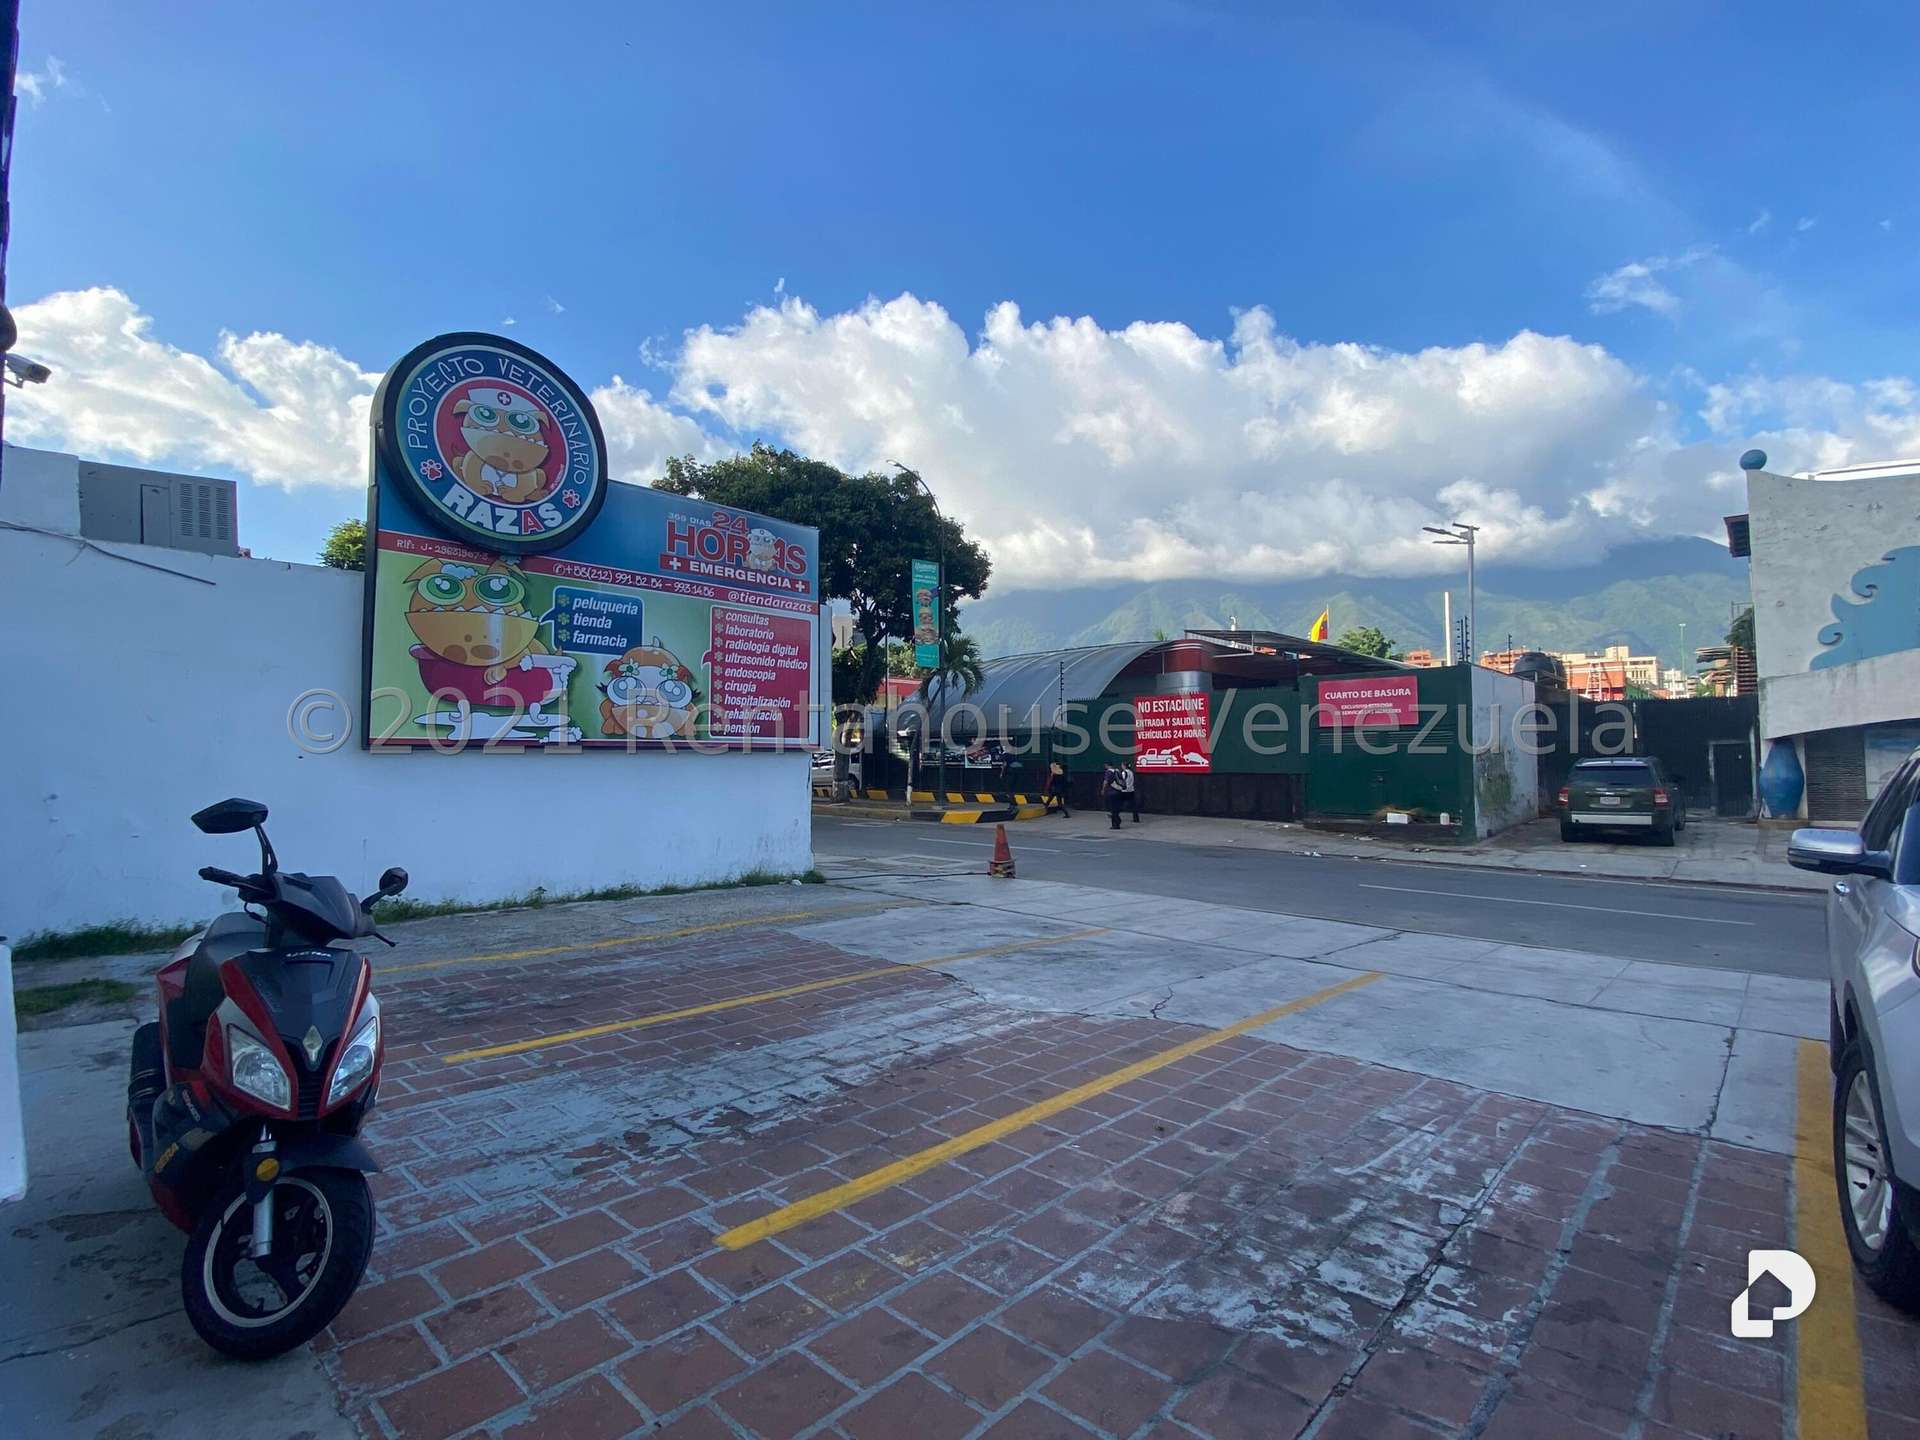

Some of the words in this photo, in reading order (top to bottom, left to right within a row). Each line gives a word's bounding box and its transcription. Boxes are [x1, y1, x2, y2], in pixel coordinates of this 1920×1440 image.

[408, 356, 484, 449] PROYECTO
[498, 358, 590, 485] VETERINARIO
[442, 483, 563, 535] RAZAS
[712, 511, 749, 535] 24
[689, 560, 792, 589] EMERGENCIA
[728, 590, 812, 613] @tiendarazas
[573, 613, 612, 629] tienda
[725, 612, 769, 625] consultas
[572, 630, 627, 648] farmacia
[725, 624, 774, 640] laboratorio
[772, 645, 799, 657] digital
[725, 653, 776, 667] ultrasonido
[777, 659, 808, 670] médico
[724, 680, 757, 694] cirugía
[1324, 691, 1359, 700] CUARTO
[1360, 690, 1372, 698] DE
[1374, 688, 1411, 697] BASURA
[724, 694, 791, 708] hospitalización
[1137, 701, 1151, 713] NO
[1152, 698, 1205, 713] ESTACIONE
[723, 723, 760, 735] pensión
[1135, 718, 1165, 728] ENTRADA
[1165, 718, 1171, 727] Y
[1172, 716, 1195, 726] SALIDA
[1196, 716, 1206, 726] DE
[1137, 729, 1172, 740] VEHÍCULOS
[1173, 729, 1183, 739] 24
